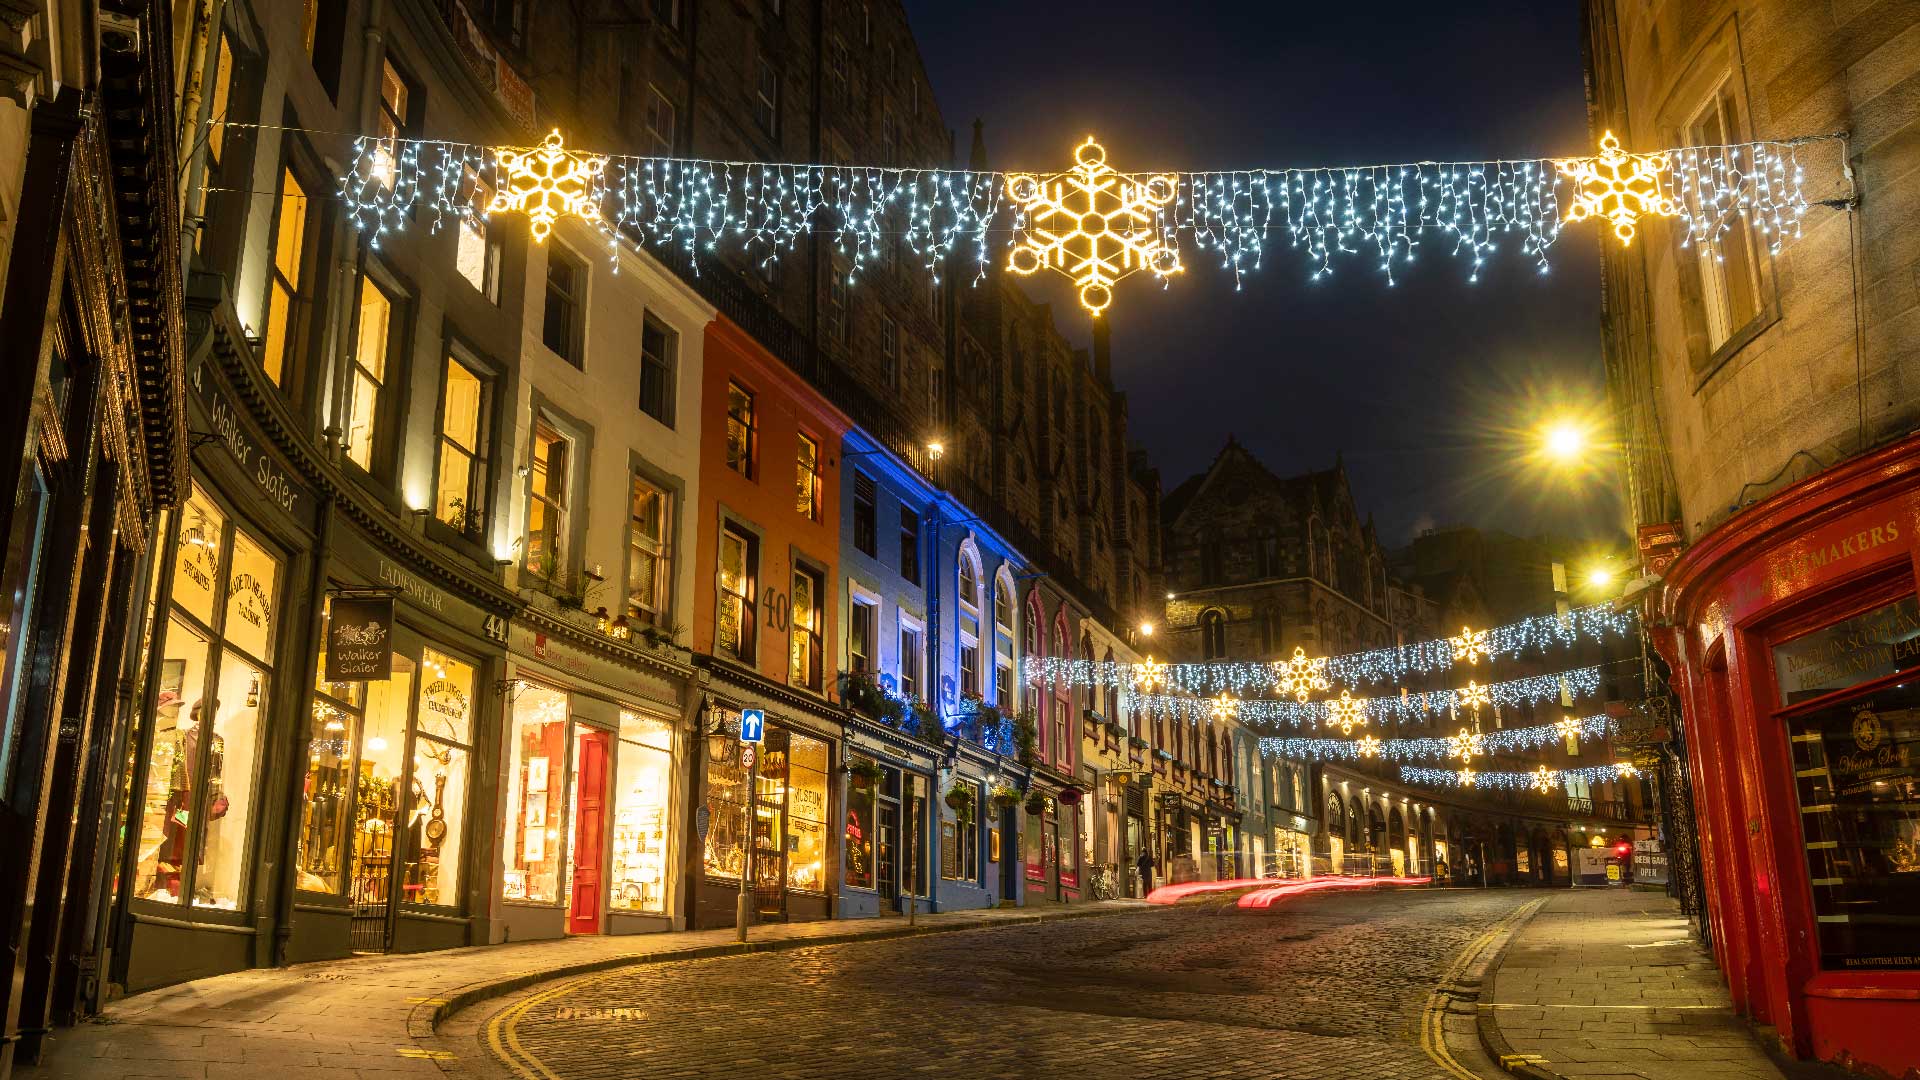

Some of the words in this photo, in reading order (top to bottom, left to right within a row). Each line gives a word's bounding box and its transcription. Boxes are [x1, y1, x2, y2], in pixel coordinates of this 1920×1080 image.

[212, 392, 251, 464] Walker
[258, 456, 297, 511] Slater
[379, 560, 442, 612] LADIESWEAR
[762, 586, 788, 632] 40
[535, 643, 546, 656] red
[743, 753, 753, 763] 20
[794, 788, 821, 810] MUSEUM
[1634, 855, 1651, 865] BEER
[1640, 867, 1657, 878] OPEN
